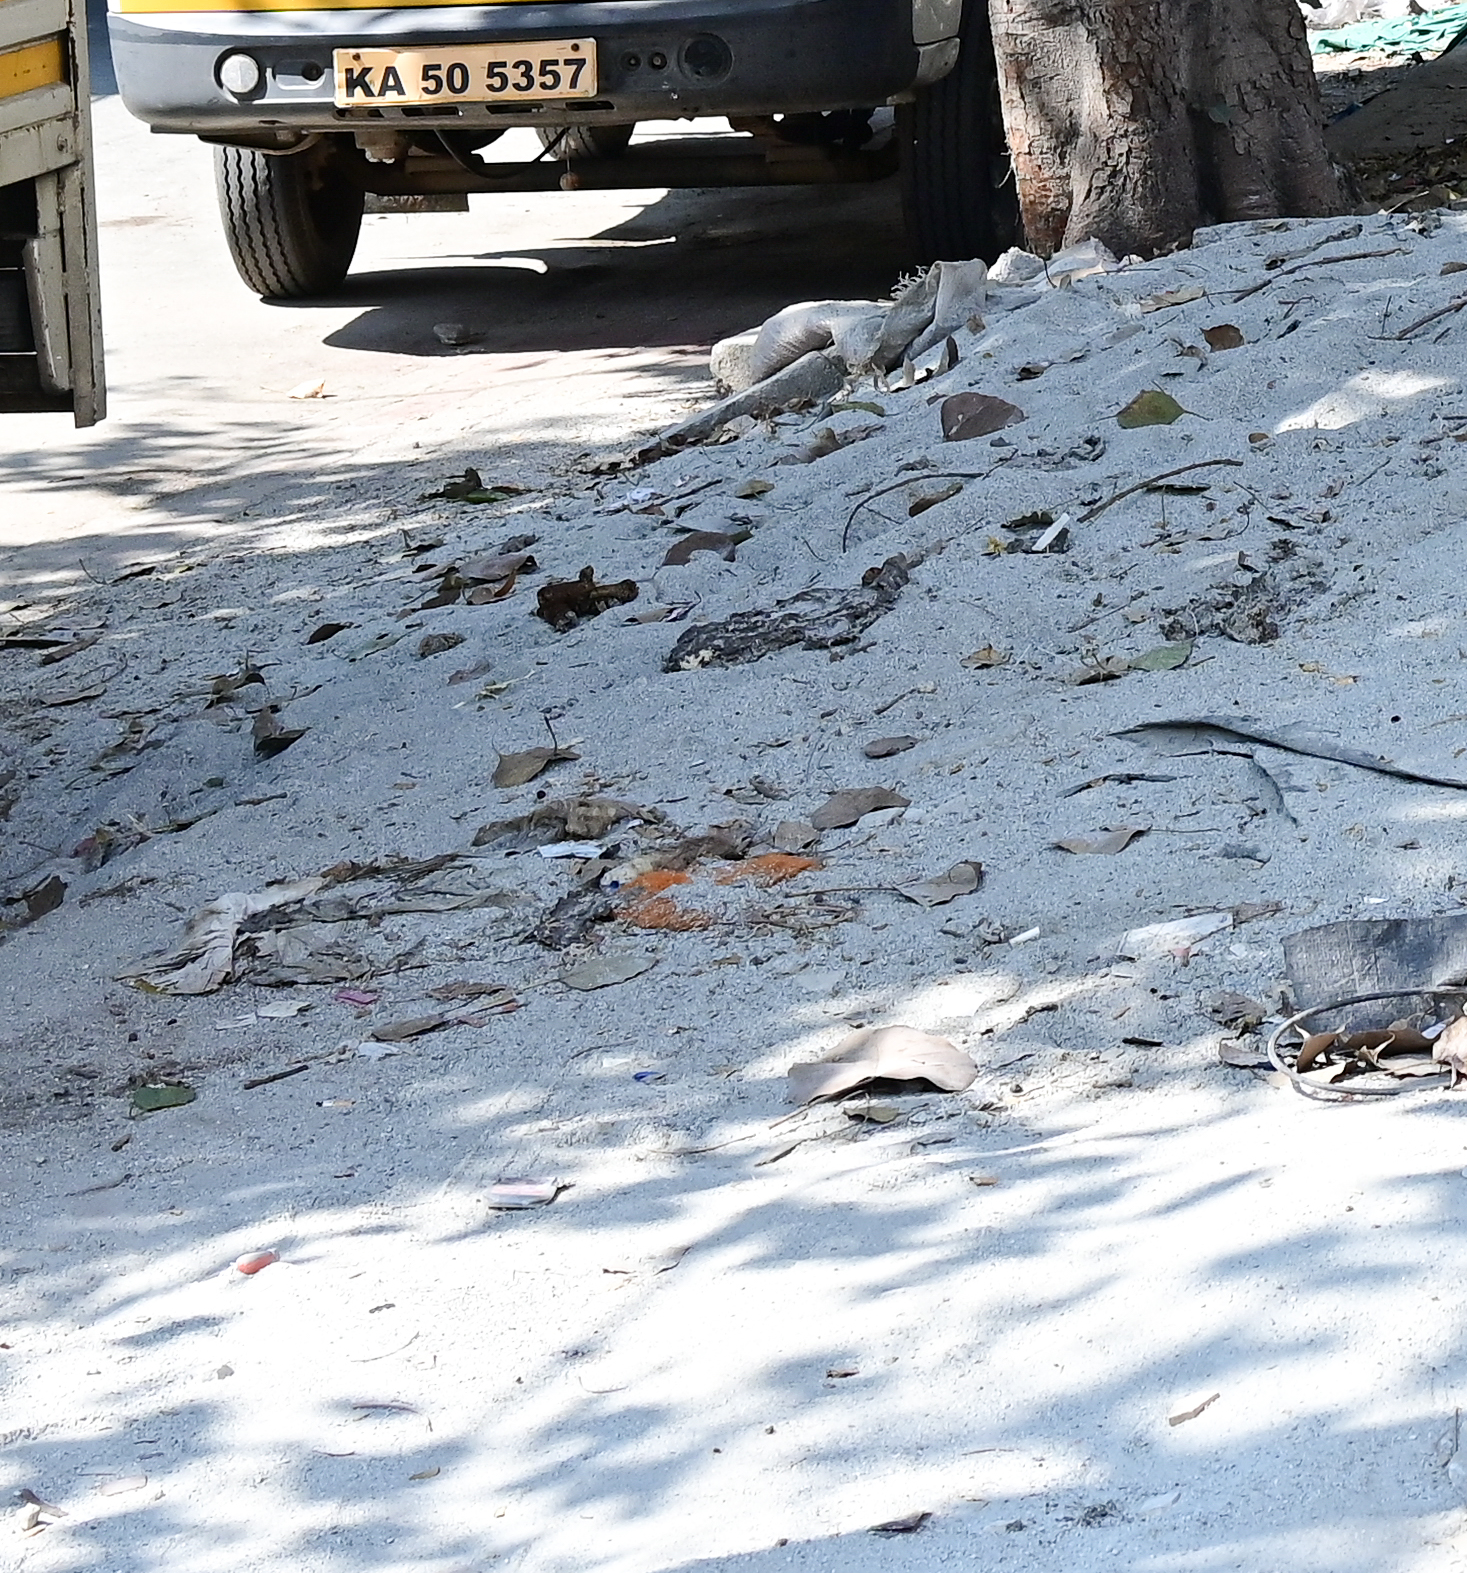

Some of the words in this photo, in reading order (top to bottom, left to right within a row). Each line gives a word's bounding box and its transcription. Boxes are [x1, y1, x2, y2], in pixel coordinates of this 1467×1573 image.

[345, 66, 407, 98] KA
[421, 63, 470, 95] 50
[485, 57, 587, 93] 5357
